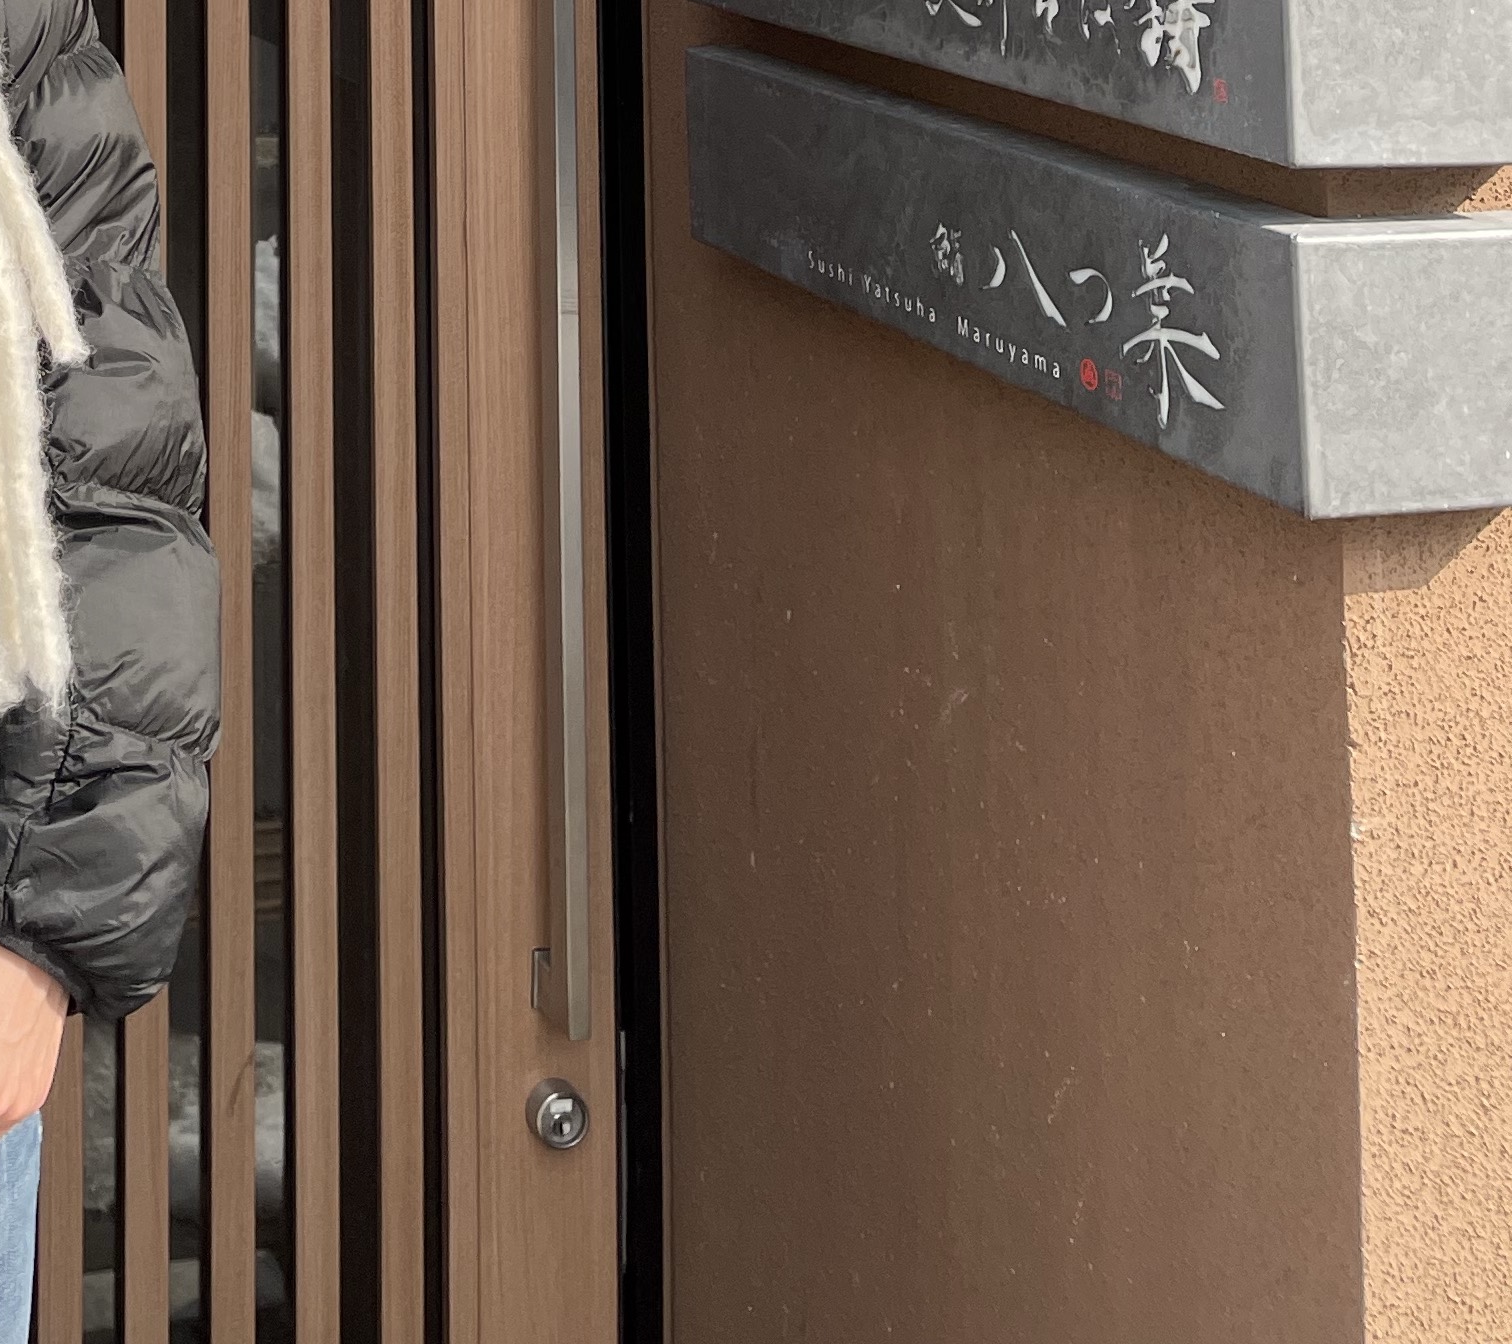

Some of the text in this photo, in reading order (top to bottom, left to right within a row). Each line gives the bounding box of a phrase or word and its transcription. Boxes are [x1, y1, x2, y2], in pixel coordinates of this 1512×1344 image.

[807, 250, 853, 286] Sushi
[862, 273, 936, 323] Yatsuha
[957, 316, 1061, 379] Maruyama
